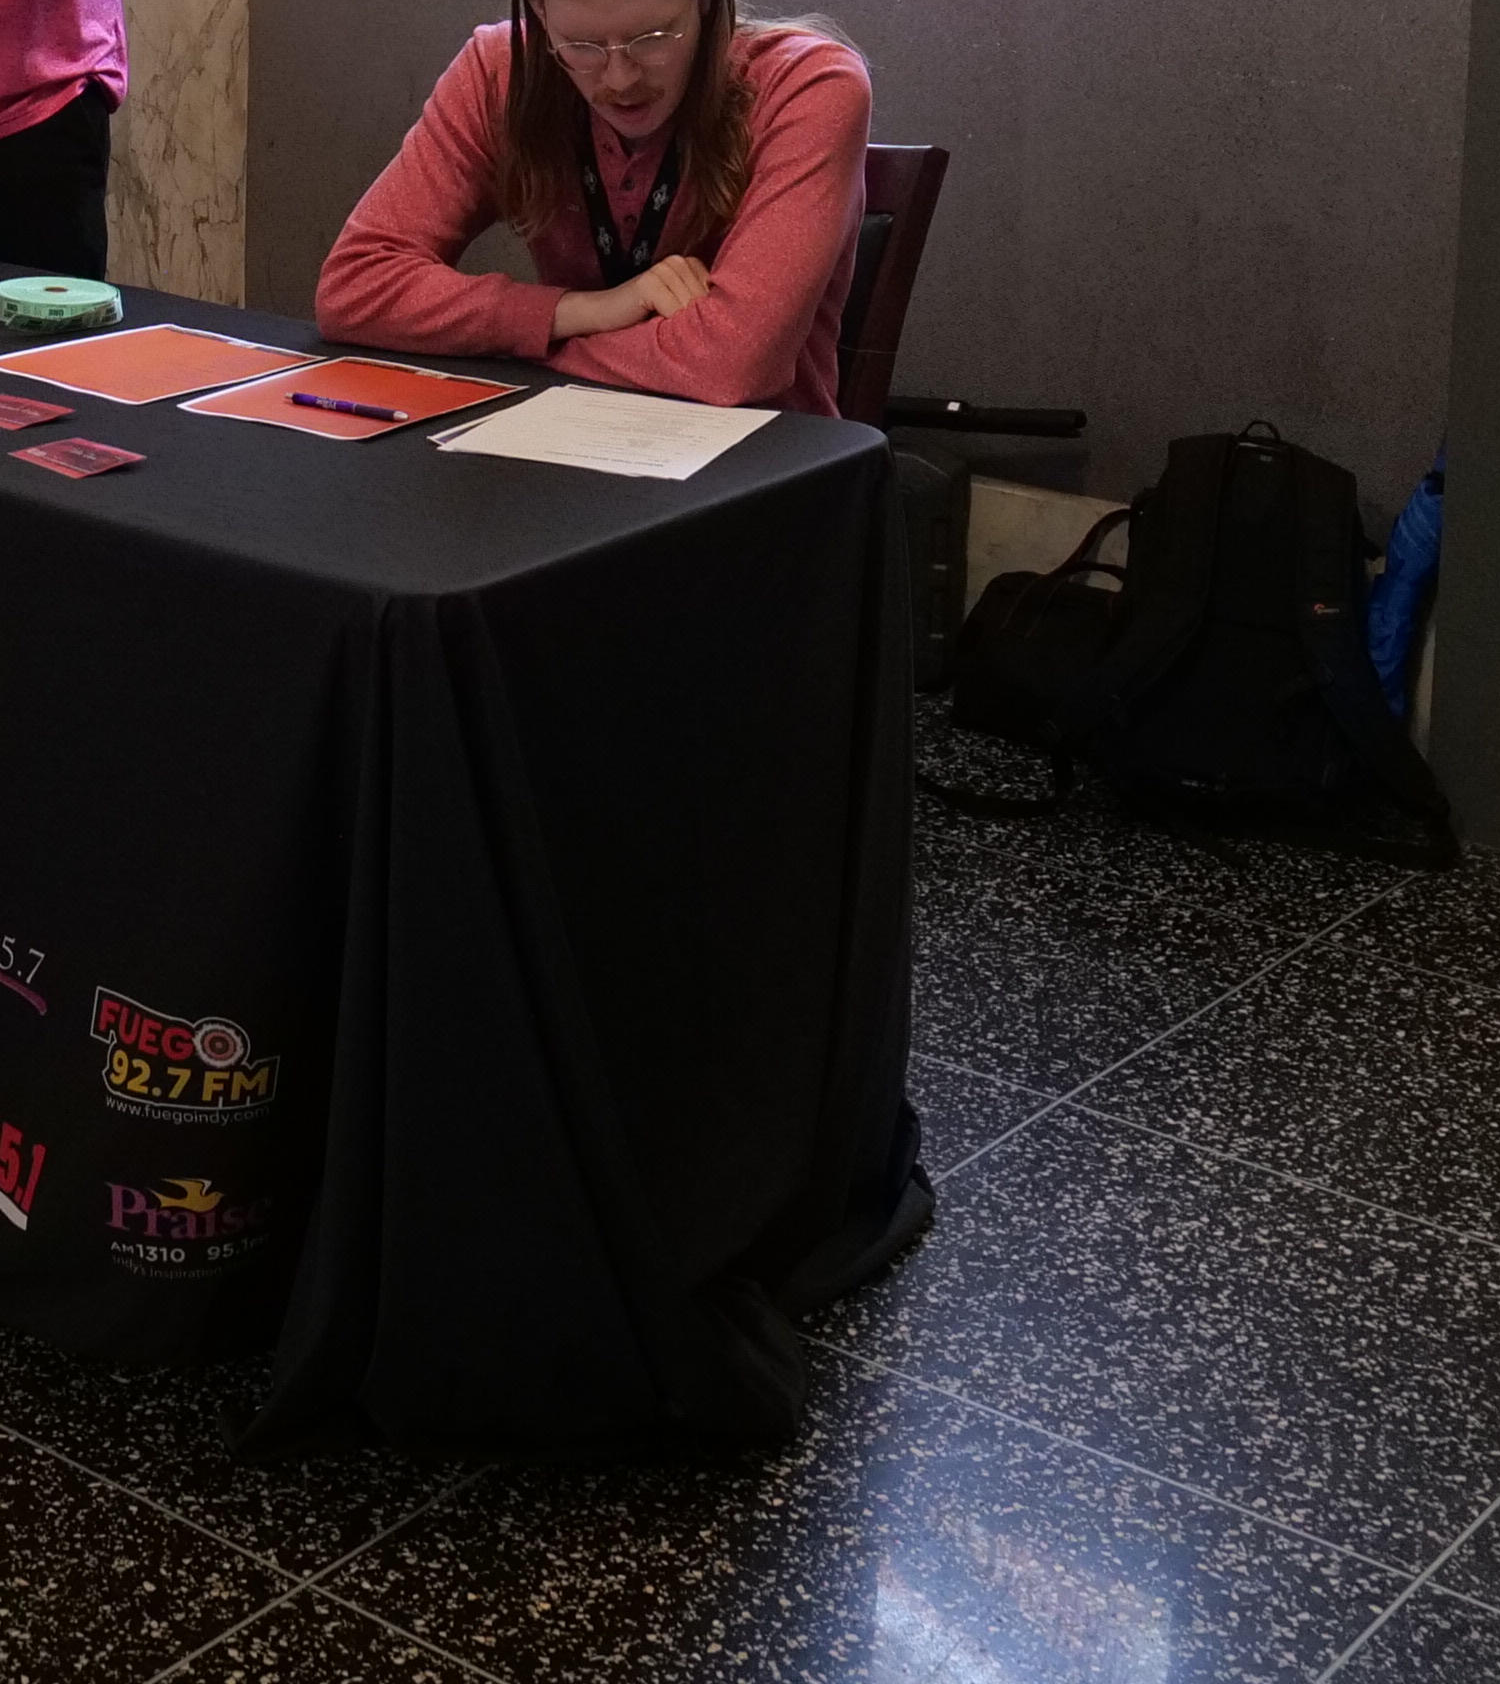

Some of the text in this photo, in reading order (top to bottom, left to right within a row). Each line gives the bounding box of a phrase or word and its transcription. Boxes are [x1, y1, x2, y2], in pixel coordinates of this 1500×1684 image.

[109, 1049, 270, 1103] 92.7 FM
[105, 1095, 271, 1128] www.fuegoindy.com
